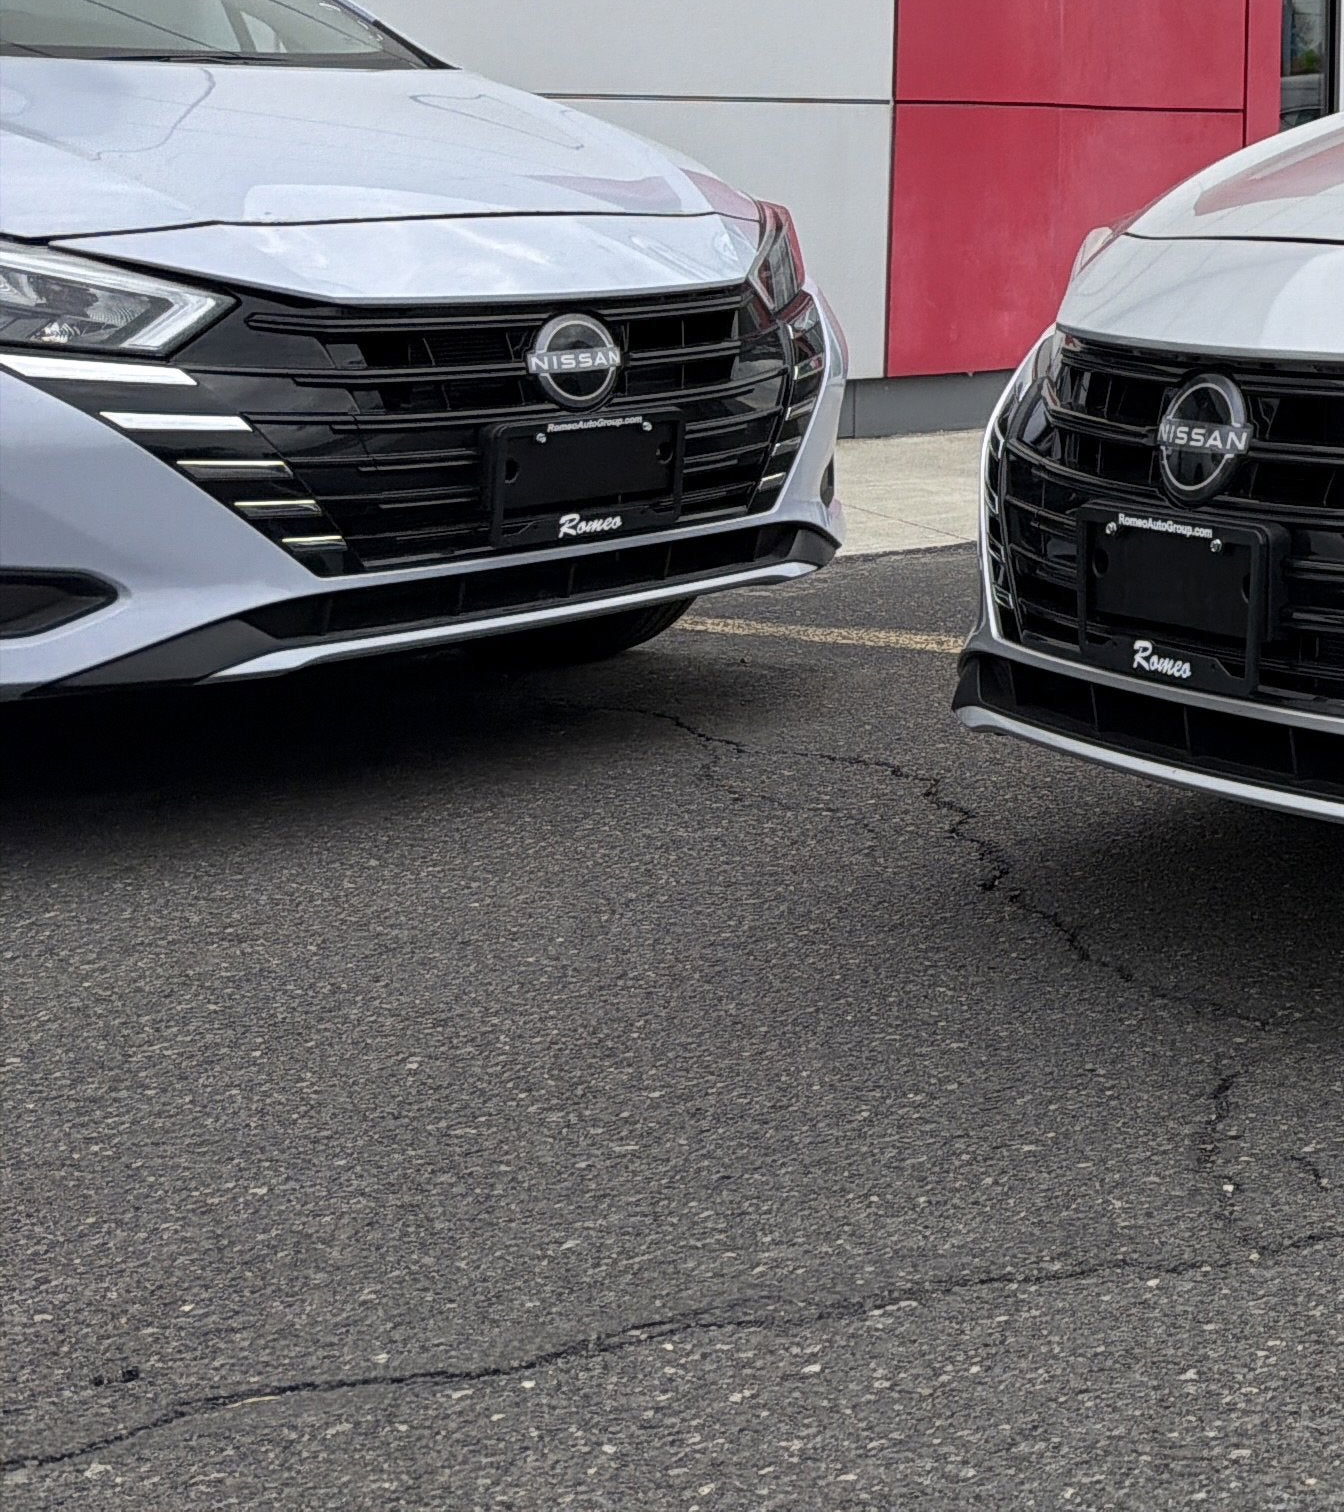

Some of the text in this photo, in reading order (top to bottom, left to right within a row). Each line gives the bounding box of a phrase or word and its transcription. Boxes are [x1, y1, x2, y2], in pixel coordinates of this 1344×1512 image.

[528, 350, 621, 372] NISSAN
[547, 415, 643, 433] RomeoAutoGroup.com
[1157, 423, 1248, 450] NISSAN
[558, 513, 622, 538] Romeo
[1118, 513, 1213, 538] RomeoAutoGroup.com
[1132, 640, 1192, 679] Romeo
